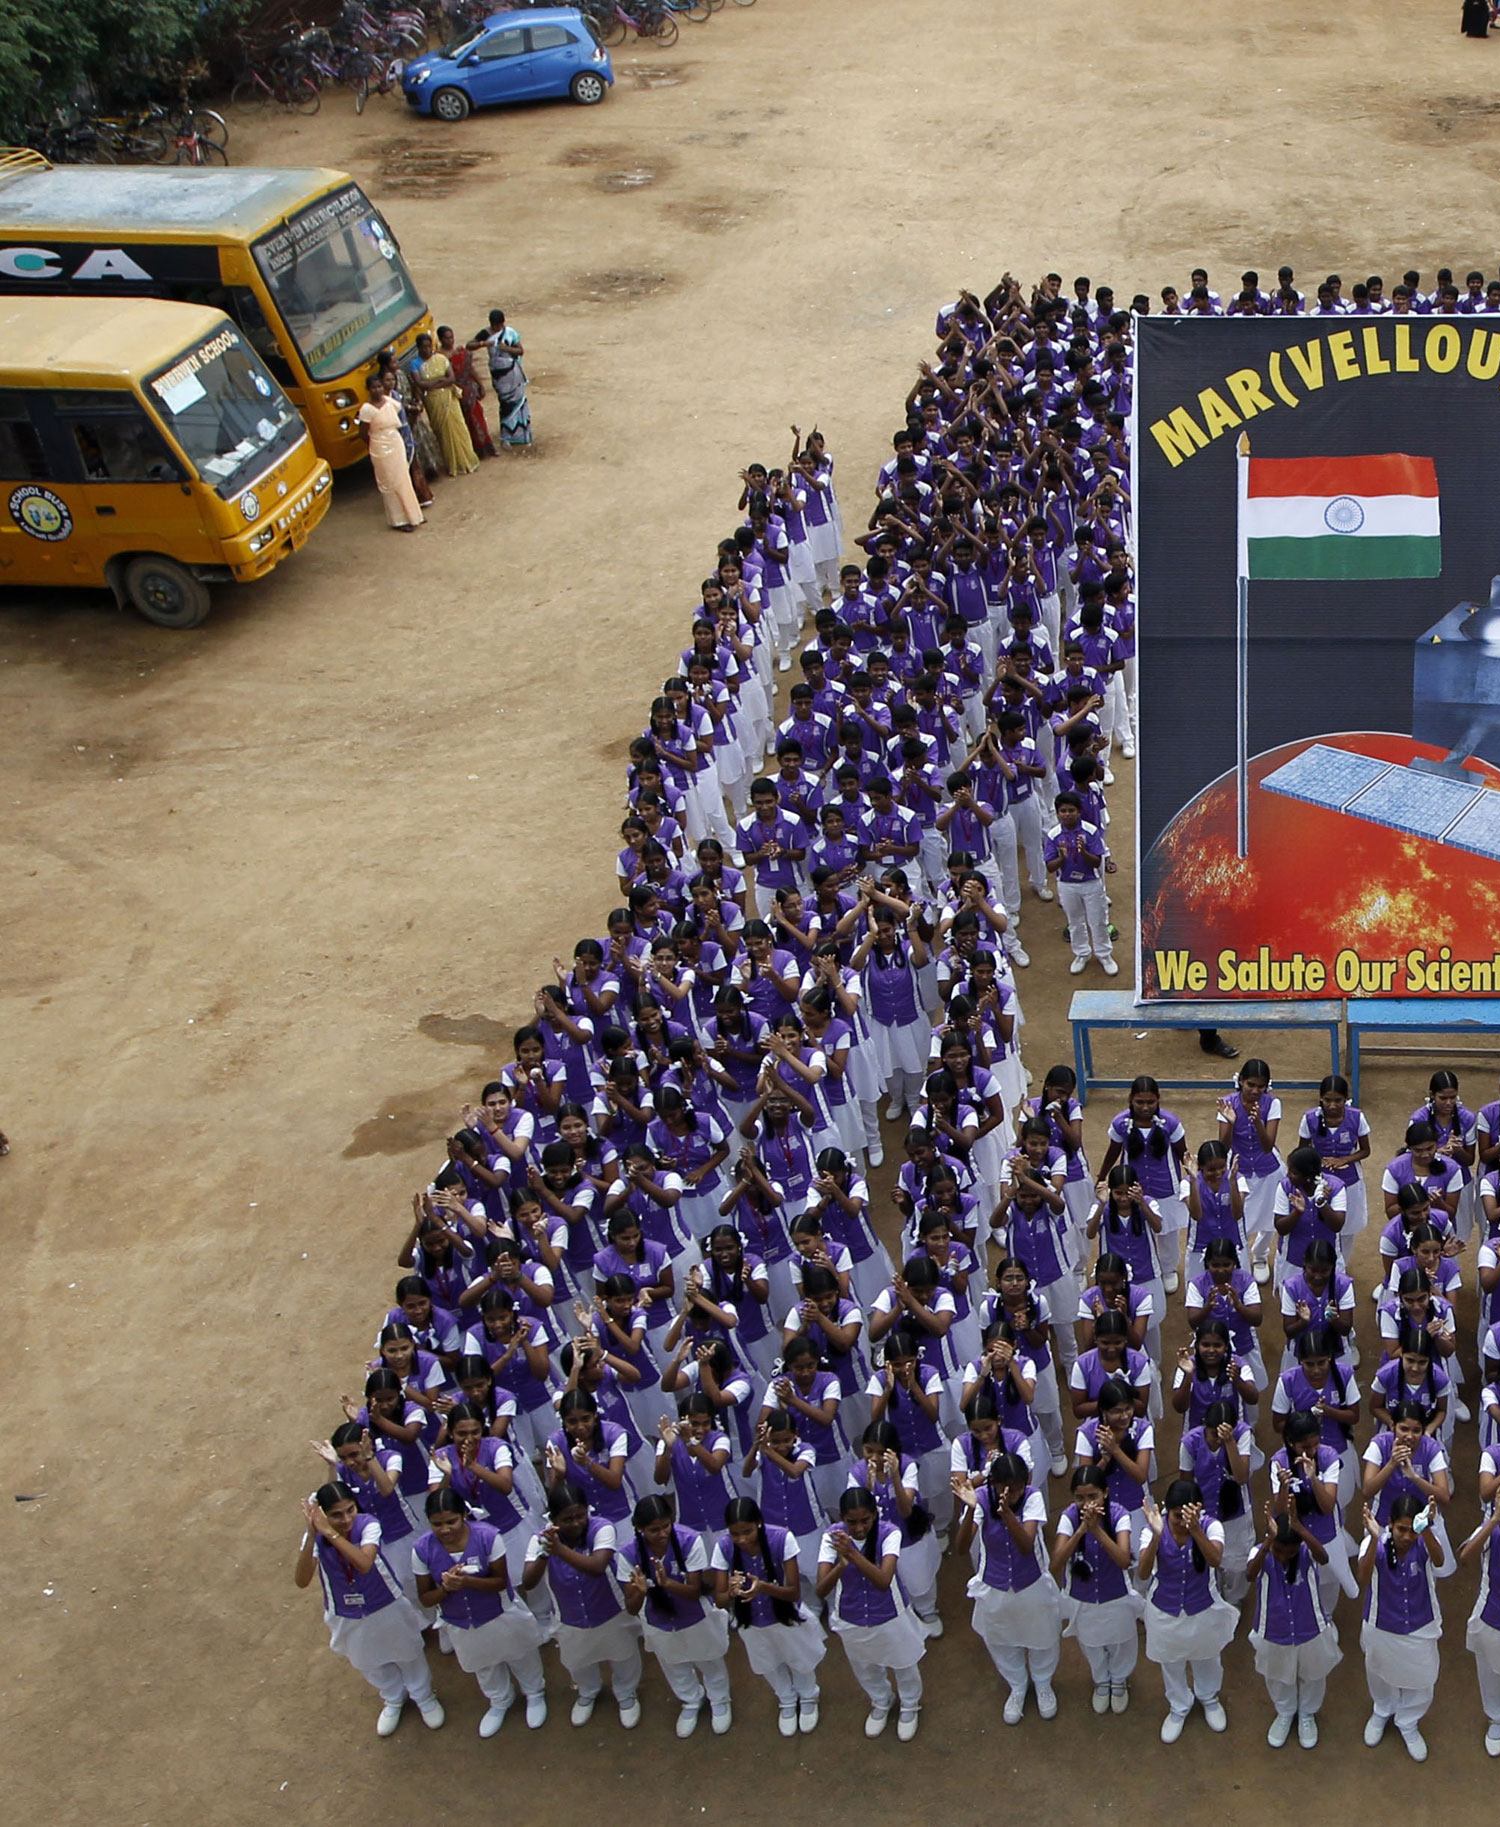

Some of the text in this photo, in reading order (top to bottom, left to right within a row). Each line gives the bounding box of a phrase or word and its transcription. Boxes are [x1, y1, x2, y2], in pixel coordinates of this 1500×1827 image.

[198, 330, 237, 364] SCHOOL
[10, 486, 67, 511] SCHOOL BUS
[1156, 949, 1207, 992] We
[1217, 947, 1325, 992] Salute
[1335, 948, 1397, 992] Our
